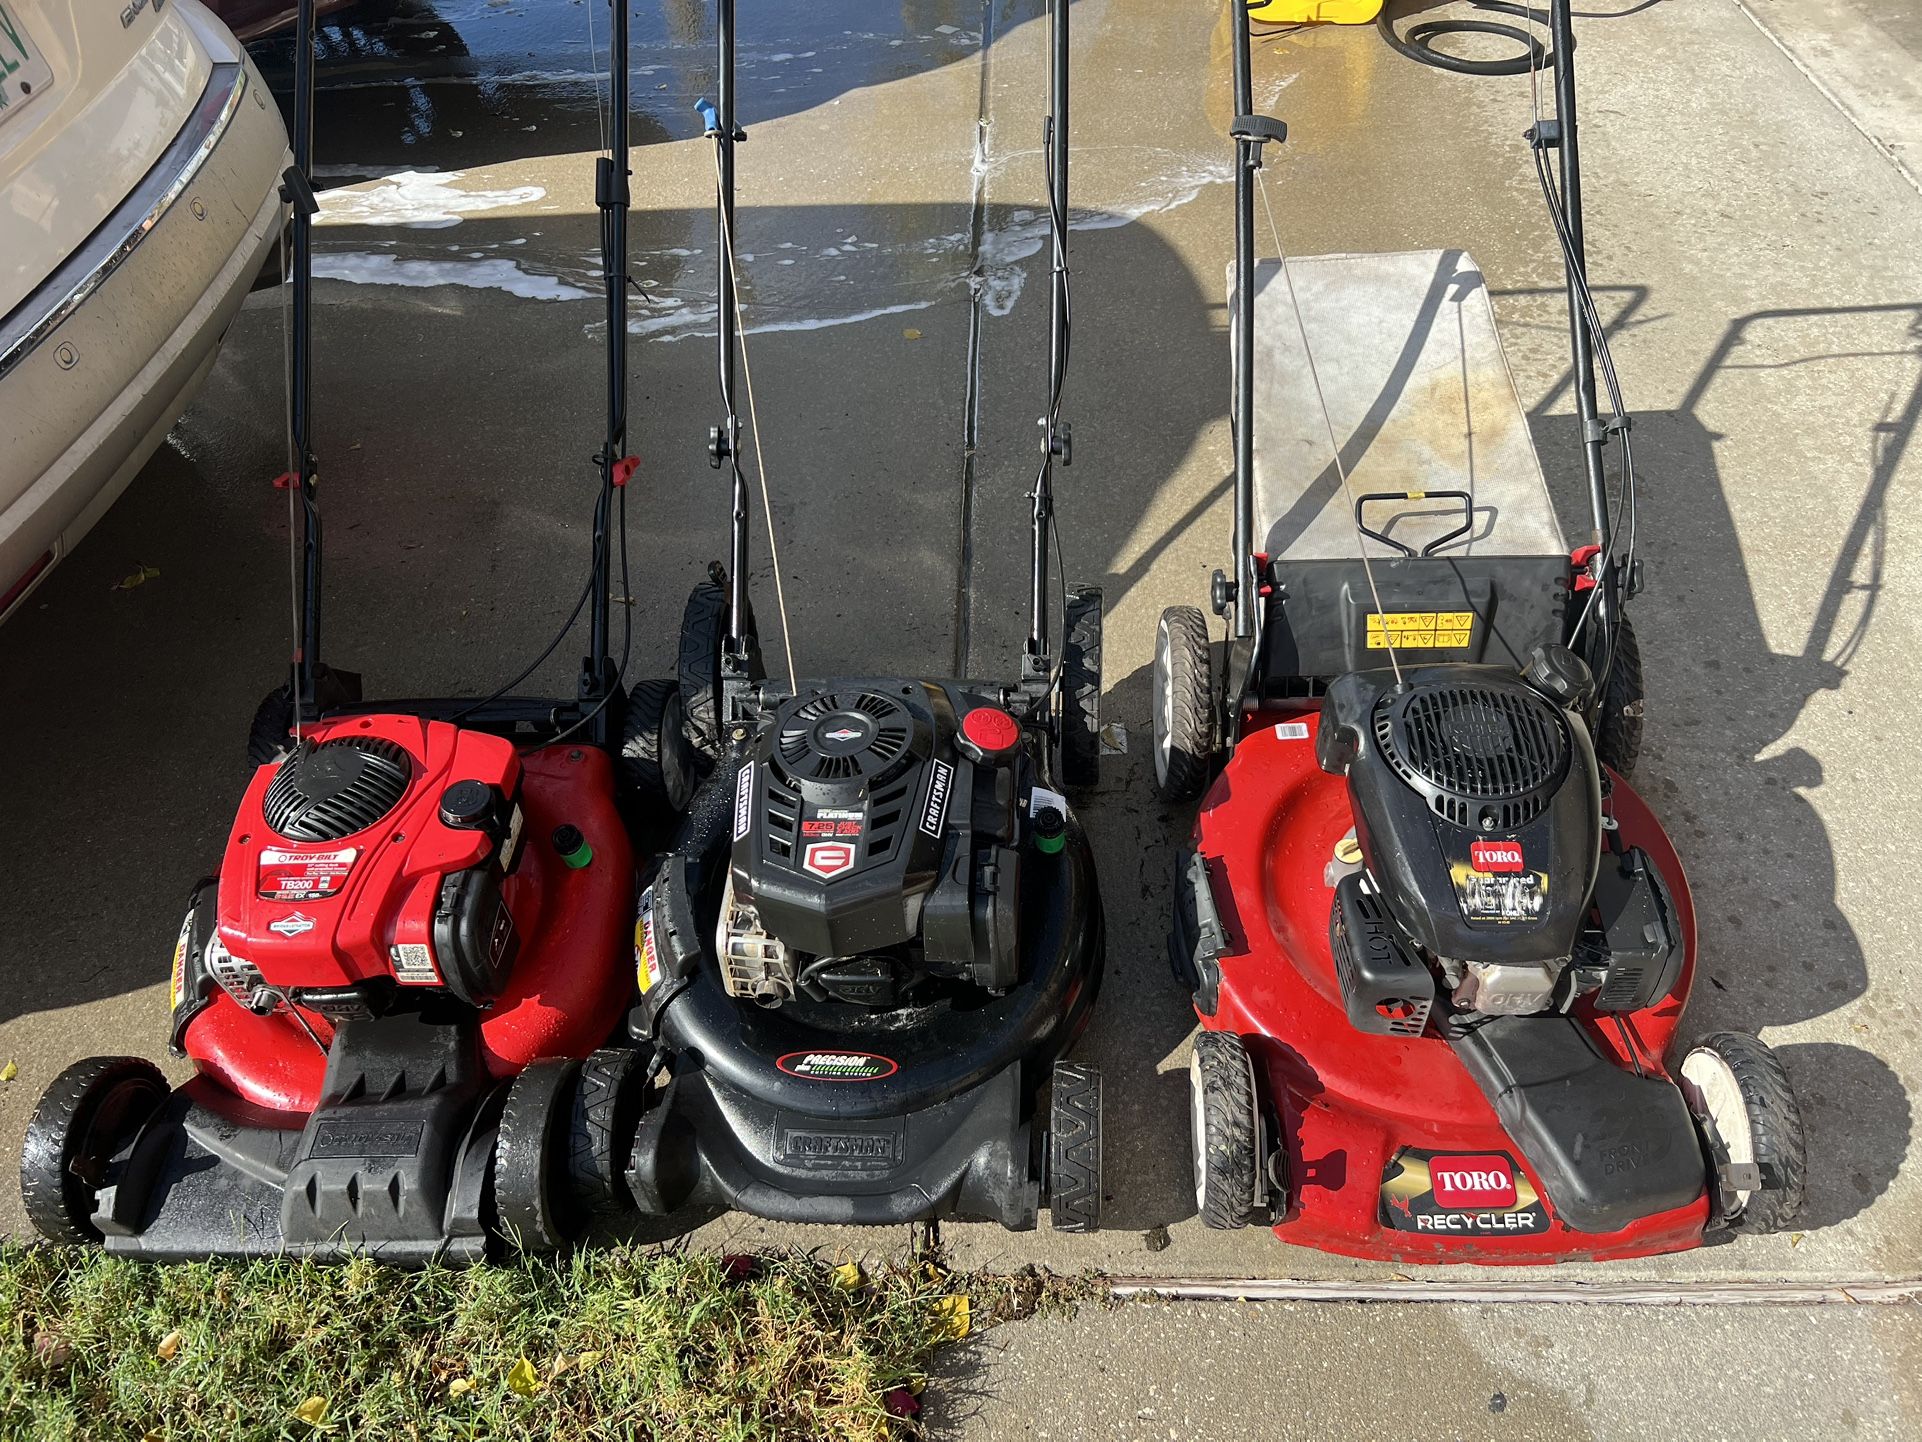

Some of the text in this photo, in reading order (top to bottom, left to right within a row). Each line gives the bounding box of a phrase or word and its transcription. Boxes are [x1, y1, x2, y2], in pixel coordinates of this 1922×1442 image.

[737, 768, 750, 834] CRAFTSMAN
[925, 766, 948, 831] CRAFTSMAN
[807, 822, 833, 830] 7.25
[1474, 850, 1519, 863] TORO
[281, 880, 313, 890] TB200
[643, 920, 657, 973] DANGER
[1364, 922, 1393, 965] HOT
[176, 943, 186, 994] DANGER
[803, 1054, 867, 1066] PRECISION
[789, 1135, 889, 1155] CRAFTSMAN
[1437, 1170, 1507, 1192] TORO
[1416, 1213, 1532, 1230] RECYCLER
